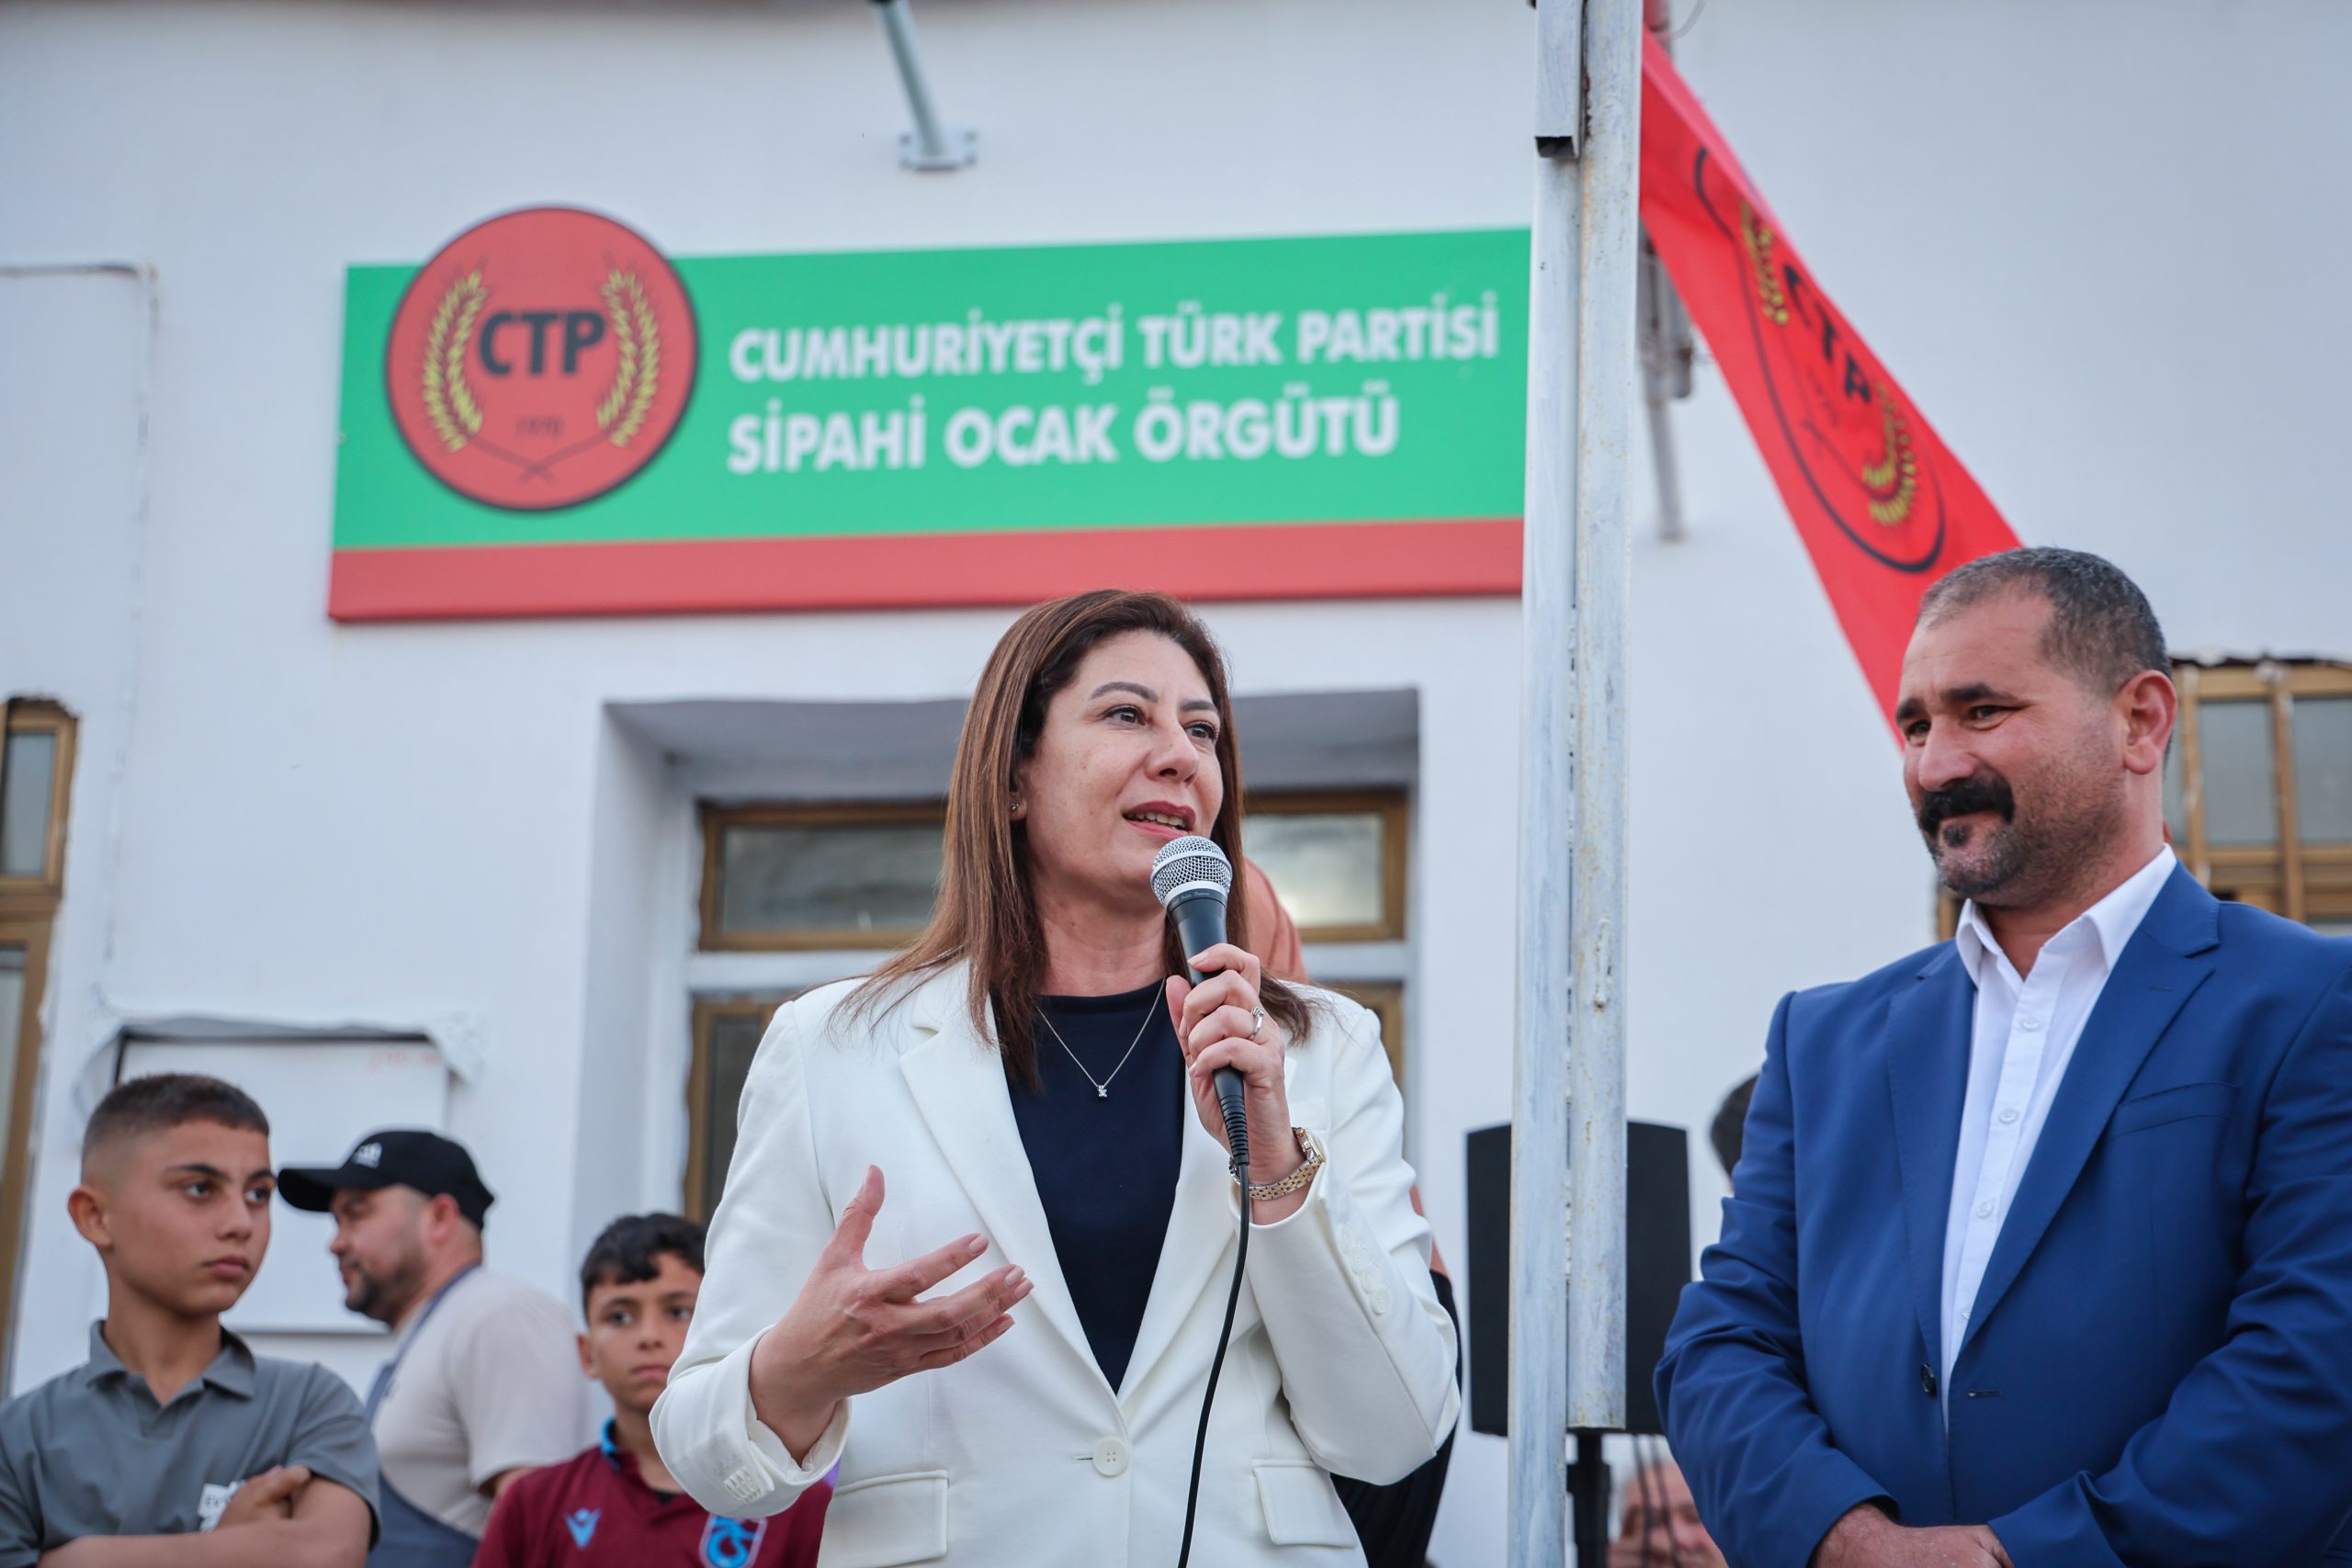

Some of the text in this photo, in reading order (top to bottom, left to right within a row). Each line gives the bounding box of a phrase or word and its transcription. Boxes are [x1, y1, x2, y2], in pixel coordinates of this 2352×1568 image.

[479, 310, 608, 378] CTP
[729, 291, 1499, 386] CUMHURİYETÇİ TÜRK PARTİSİ
[728, 379, 1399, 474] SİPAHİ OCAK ÖRGÜTÜ
